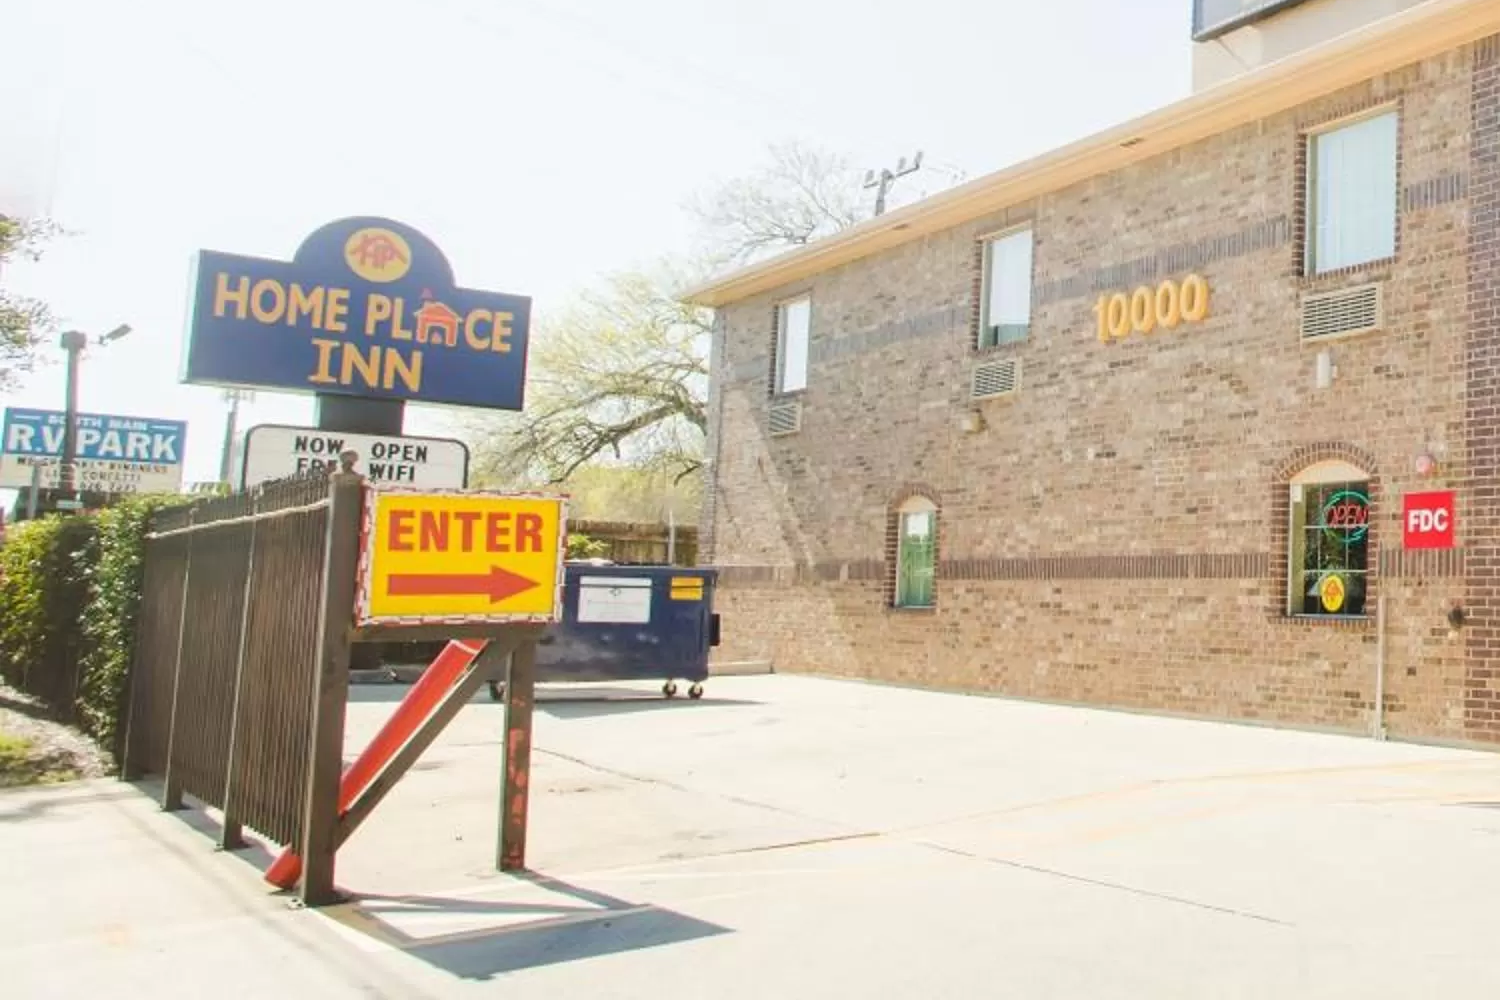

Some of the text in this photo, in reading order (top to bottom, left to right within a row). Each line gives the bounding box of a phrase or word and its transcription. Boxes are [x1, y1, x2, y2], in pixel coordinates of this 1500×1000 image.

[213, 273, 514, 352] HOME PLACE
[1092, 273, 1210, 342] 10000
[308, 338, 423, 393] INN
[77, 429, 176, 461] PARK
[295, 436, 428, 463] NOW OPEN
[369, 463, 415, 482] WIFI
[388, 509, 544, 553] ENTER
[1324, 503, 1369, 528] OPEN
[1408, 508, 1449, 533] FDC
